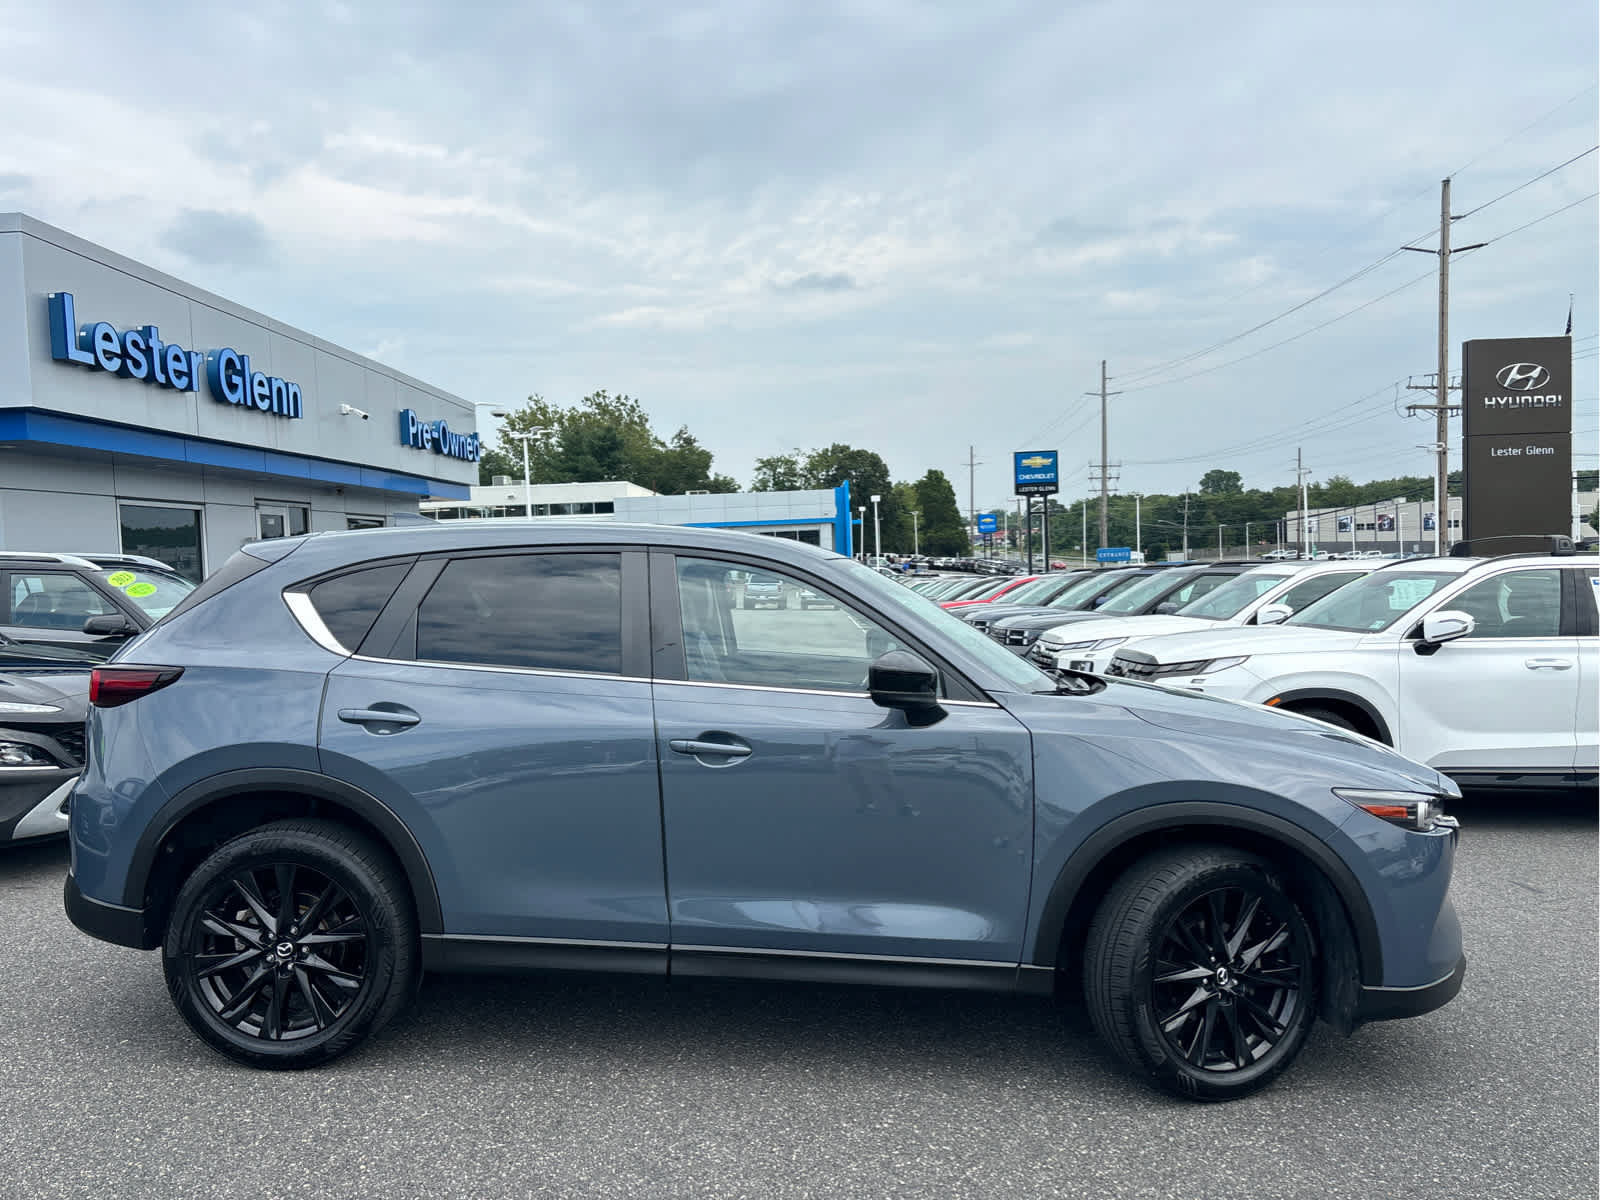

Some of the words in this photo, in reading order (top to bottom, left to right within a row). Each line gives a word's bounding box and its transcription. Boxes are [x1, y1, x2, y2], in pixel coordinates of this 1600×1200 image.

[50, 292, 203, 392] Lester
[209, 347, 303, 419] Glenn
[1484, 395, 1562, 409] HYUNDAI
[400, 409, 480, 461] Pre-Owned
[1491, 447, 1522, 457] Lester
[1526, 445, 1554, 455] Glenn
